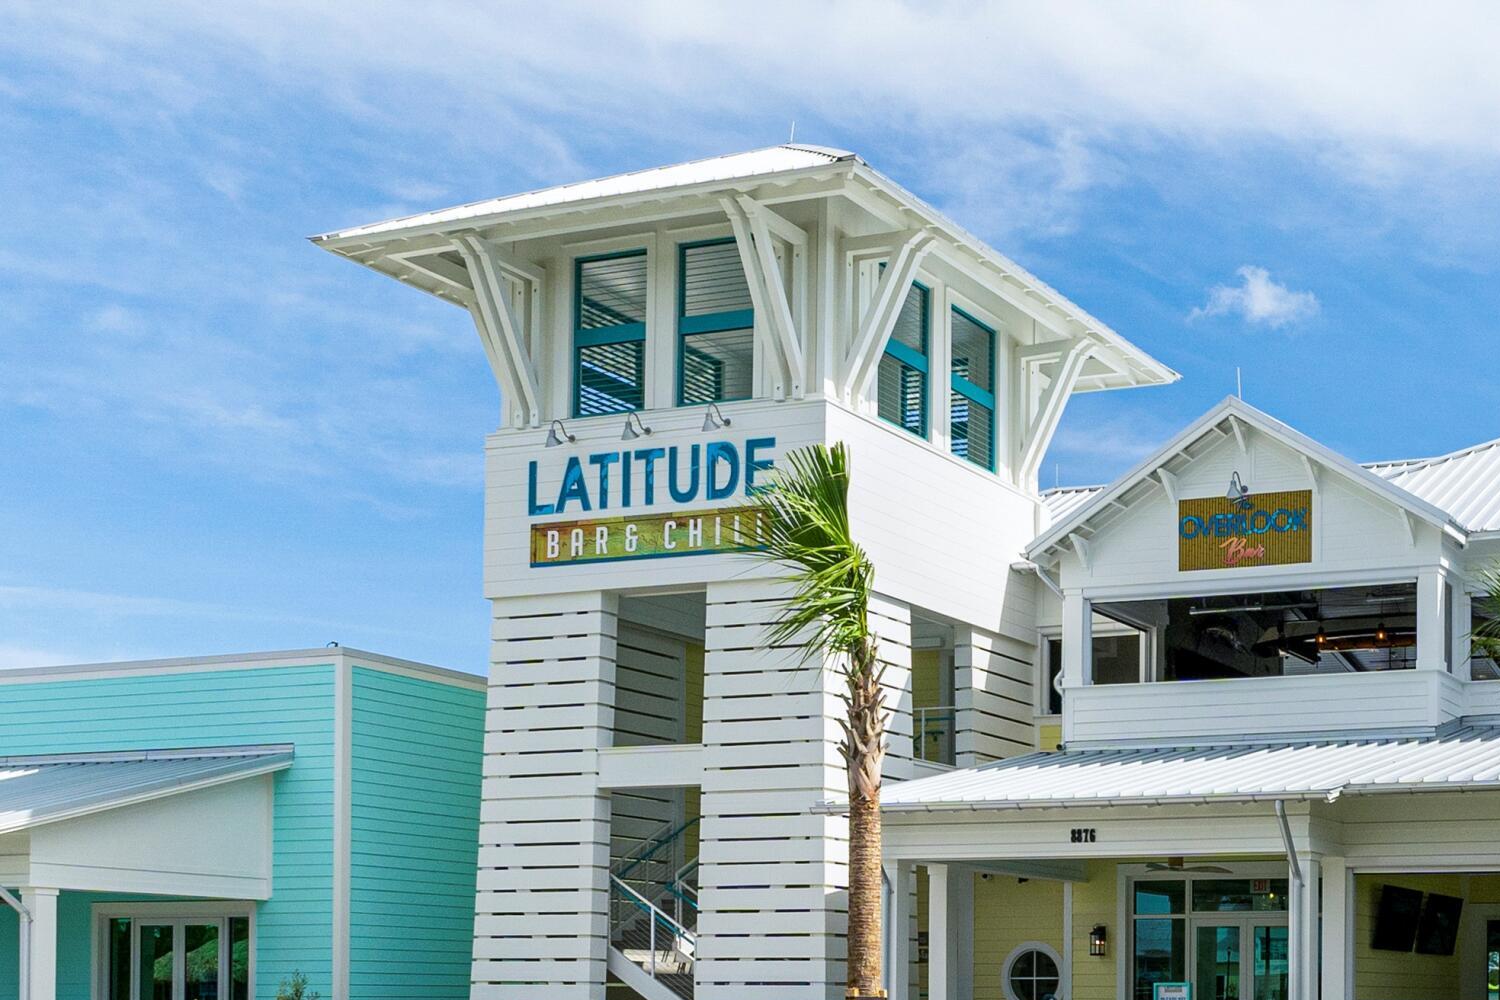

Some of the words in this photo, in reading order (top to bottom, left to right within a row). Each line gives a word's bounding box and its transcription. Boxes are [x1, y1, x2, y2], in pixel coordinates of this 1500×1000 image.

[528, 437, 777, 516] LATITUDE
[547, 527, 608, 559] BAR
[624, 524, 638, 551] &
[664, 513, 766, 549] CHILL
[1179, 507, 1308, 540] OVERLOOK
[1219, 537, 1265, 565] Bar
[1070, 828, 1096, 843] 8876
